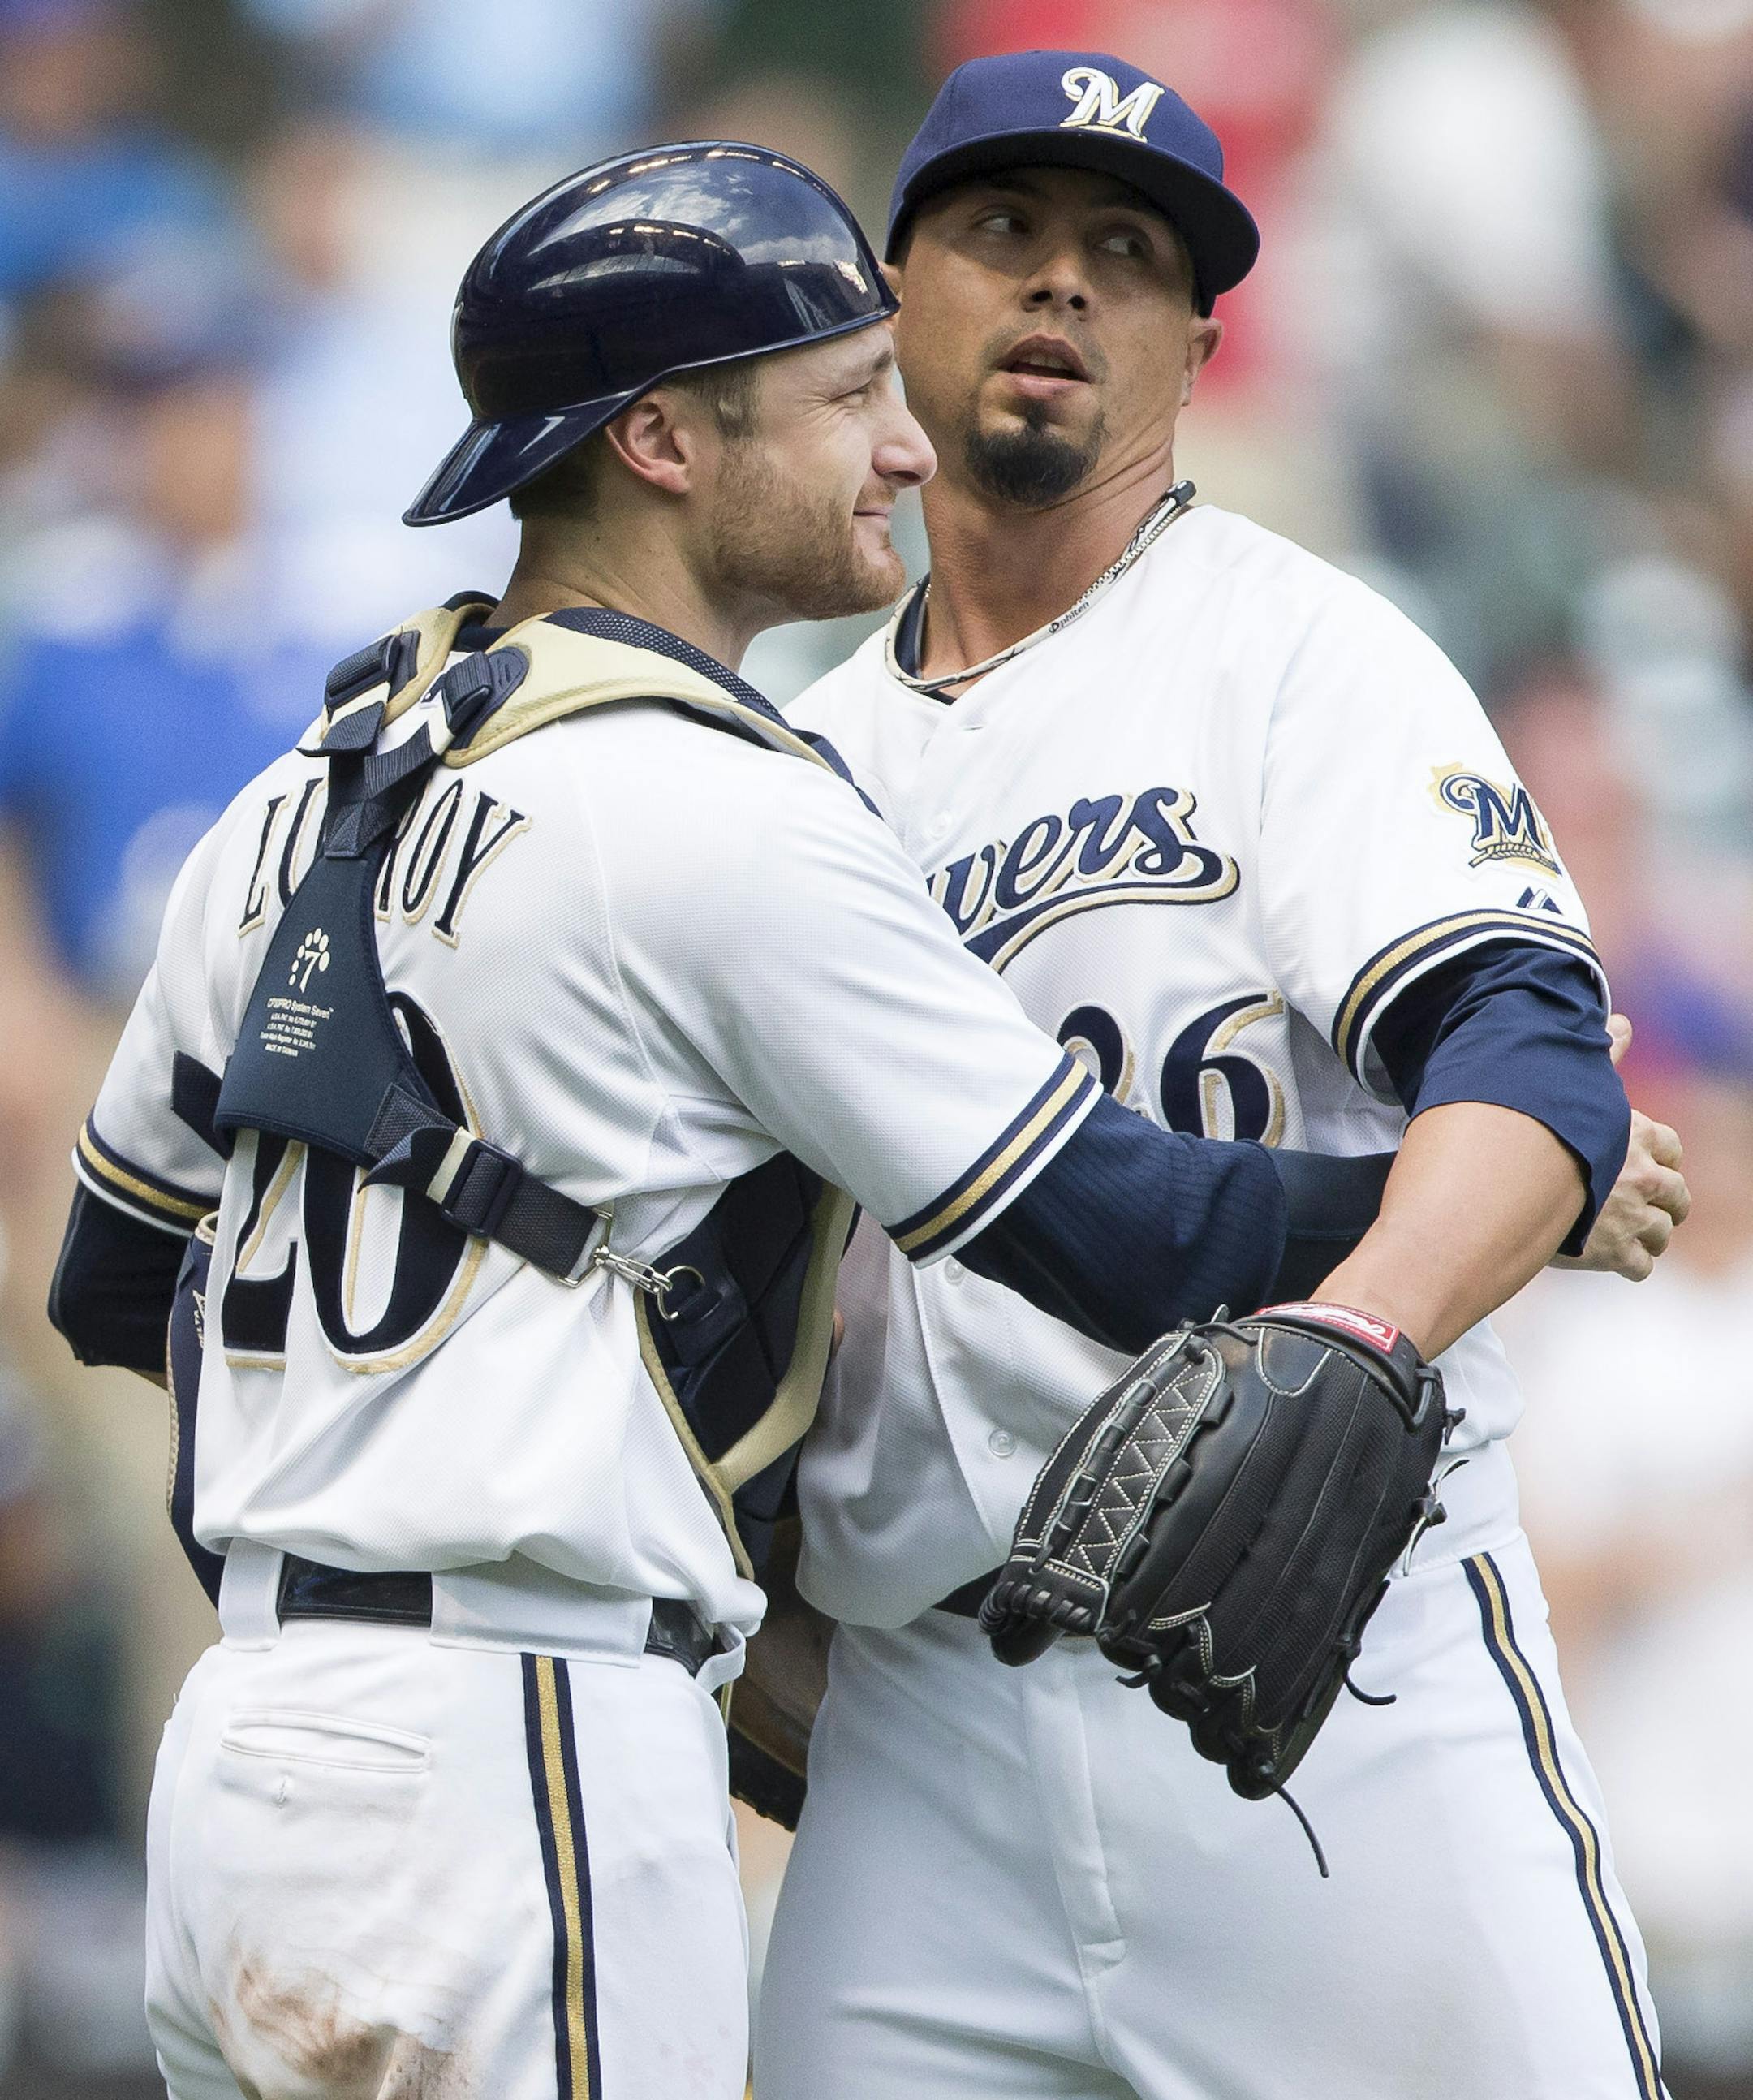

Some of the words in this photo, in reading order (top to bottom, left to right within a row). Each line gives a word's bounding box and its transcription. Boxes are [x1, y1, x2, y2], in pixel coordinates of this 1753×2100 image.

[1059, 67, 1165, 144] M
[1059, 602, 1090, 628] phiten
[238, 776, 532, 948] LUROY
